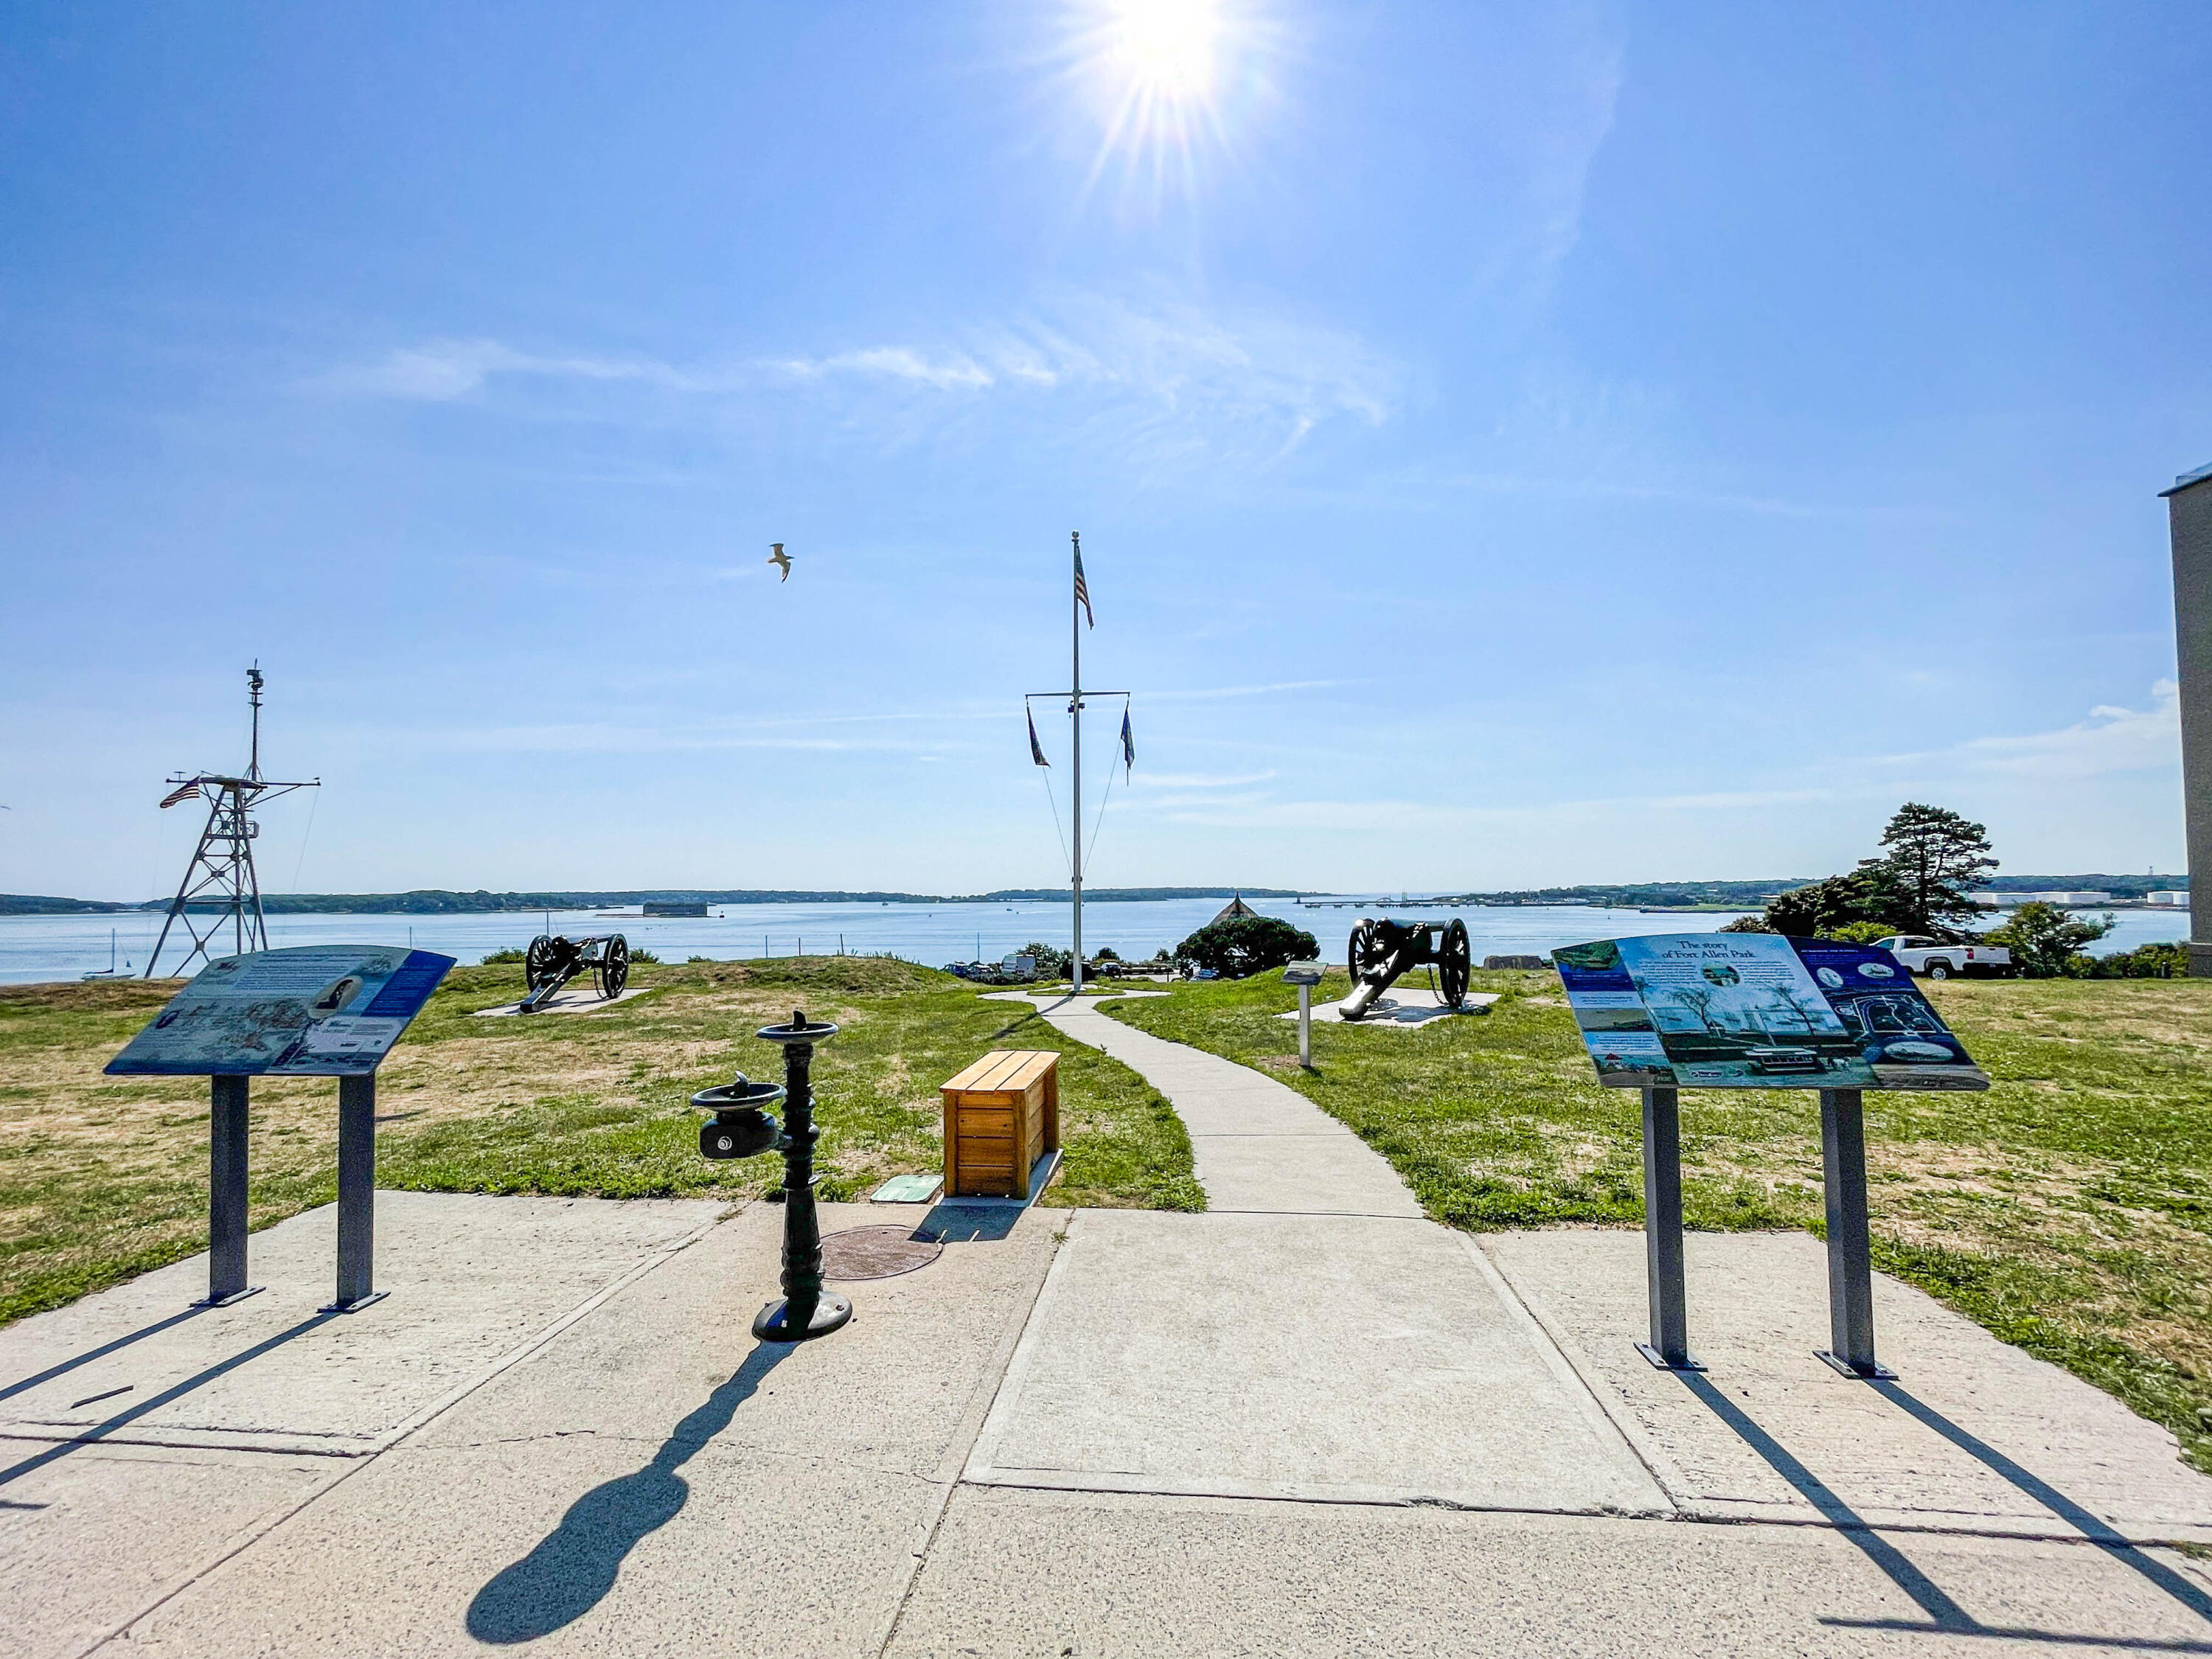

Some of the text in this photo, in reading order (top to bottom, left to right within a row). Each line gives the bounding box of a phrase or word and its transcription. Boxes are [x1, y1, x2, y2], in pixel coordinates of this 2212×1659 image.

[1676, 941, 1700, 949] The
[1662, 950, 1756, 959] of Fort Allen Park
